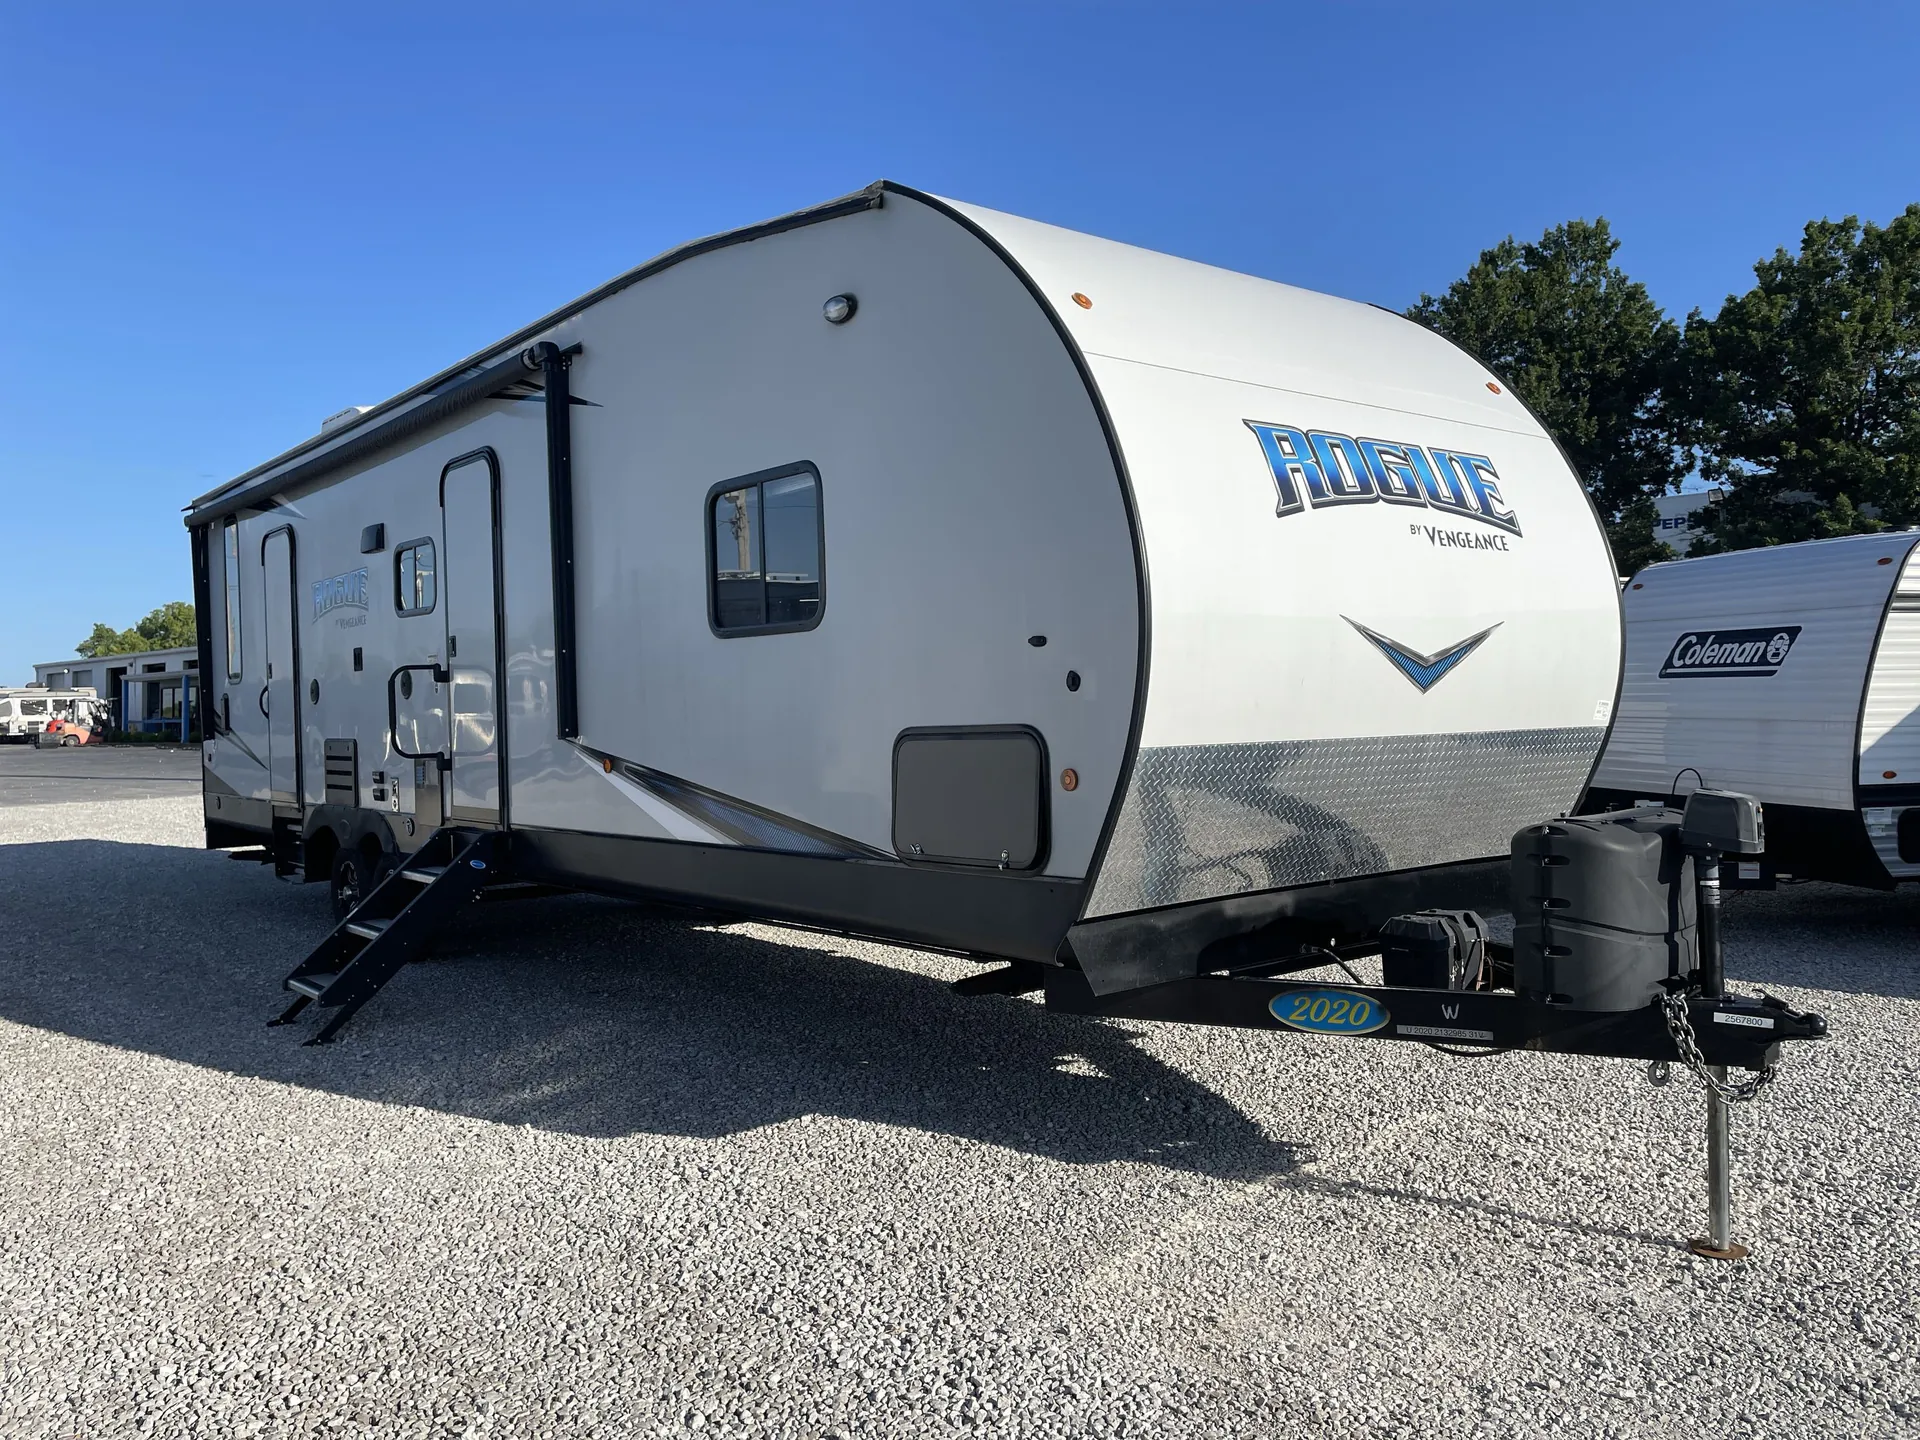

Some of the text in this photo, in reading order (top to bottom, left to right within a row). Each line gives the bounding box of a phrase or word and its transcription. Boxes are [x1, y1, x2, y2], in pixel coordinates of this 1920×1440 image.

[1242, 418, 1523, 538] ROGUE
[1651, 517, 1688, 530] PEP
[1410, 524, 1509, 551] BY VENGEANCE
[311, 566, 369, 626] ROGUE
[1672, 634, 1767, 667] Coleman
[1288, 996, 1371, 1026] 2020
[1441, 1003, 1460, 1020] W
[1724, 1014, 1763, 1027] 2567800
[1406, 1026, 1413, 1034] U
[1414, 1027, 1432, 1035] 2020
[1434, 1028, 1467, 1038] 2132985
